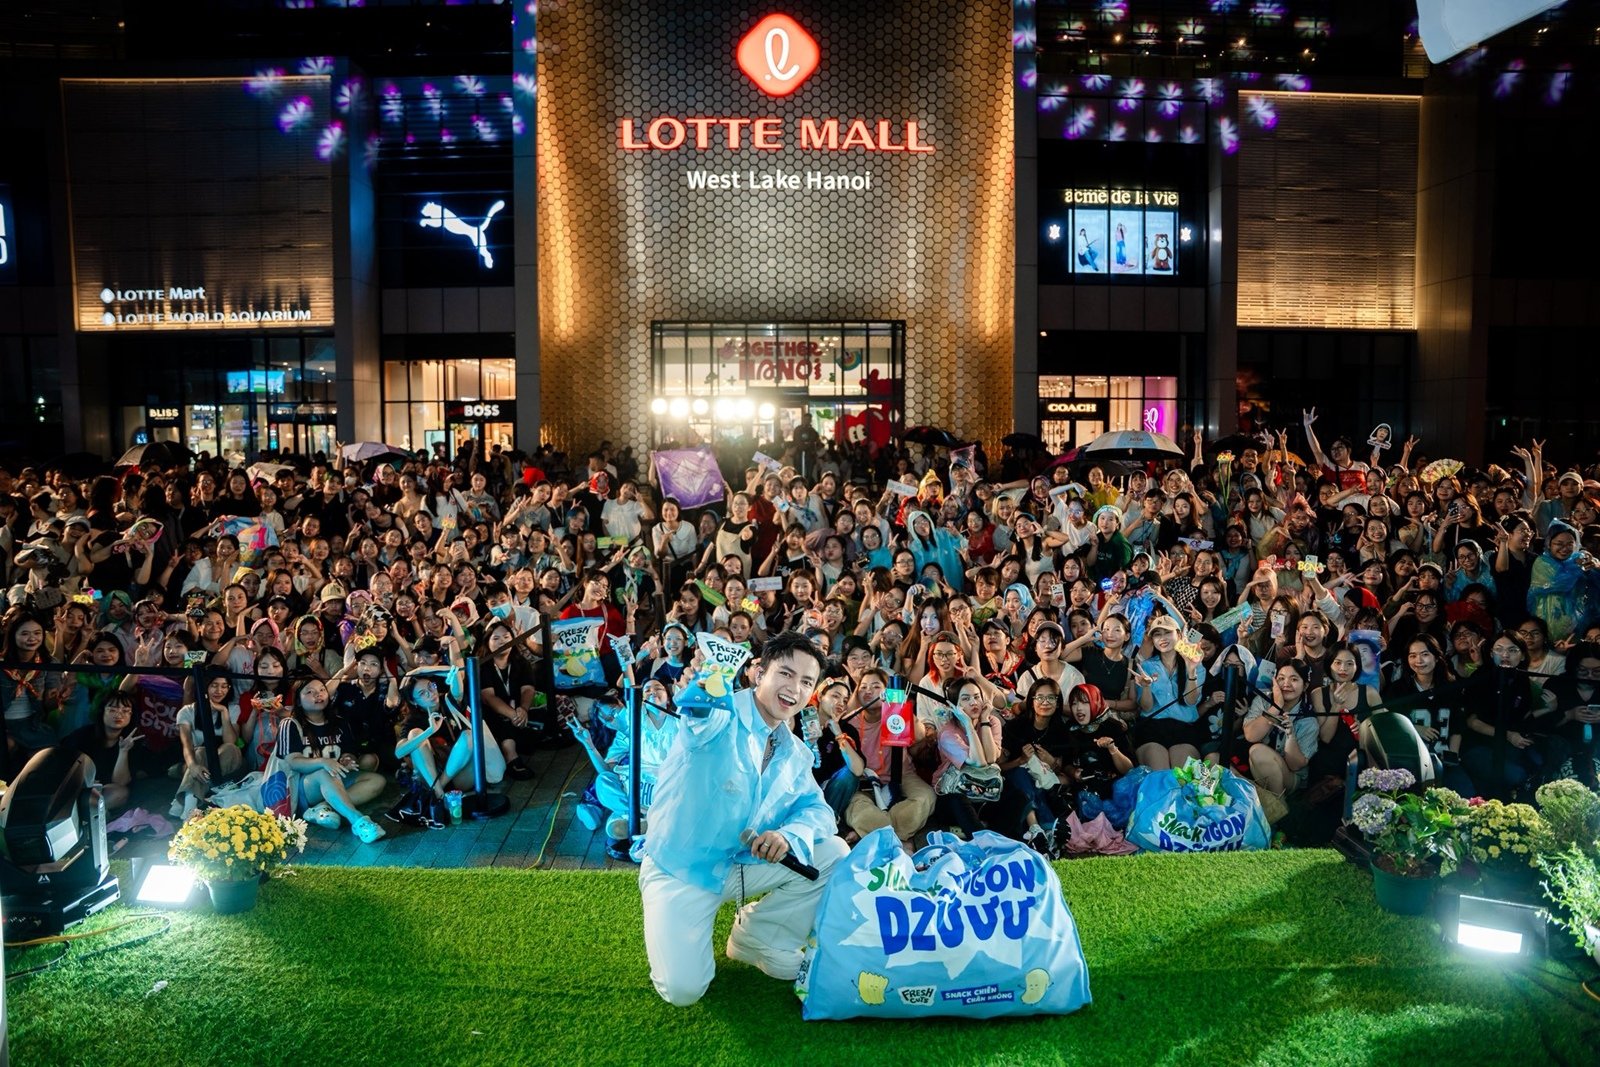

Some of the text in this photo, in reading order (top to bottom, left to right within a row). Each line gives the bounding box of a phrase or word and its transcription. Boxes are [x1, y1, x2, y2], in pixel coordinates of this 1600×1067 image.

[621, 118, 935, 153] LOTTE MALL
[687, 171, 872, 191] West Lake Hanoi
[1065, 189, 1108, 204] acme
[1111, 190, 1131, 204] de
[1153, 191, 1178, 206] vie
[117, 286, 206, 302] LOTTE Mart
[117, 309, 312, 325] LOTTE WORLD AQUARIUM
[149, 408, 179, 418] BLISS
[464, 404, 500, 417] BOSS
[1047, 403, 1097, 413] COACH
[559, 625, 592, 644] FRESH
[565, 634, 587, 647] CUTS
[707, 641, 746, 659] FRESH
[317, 734, 342, 745] YOK
[1159, 812, 1203, 842] SNACK
[901, 988, 934, 1001] FRESH
[910, 996, 929, 1004] CUTS
[945, 991, 972, 999] SNACK
